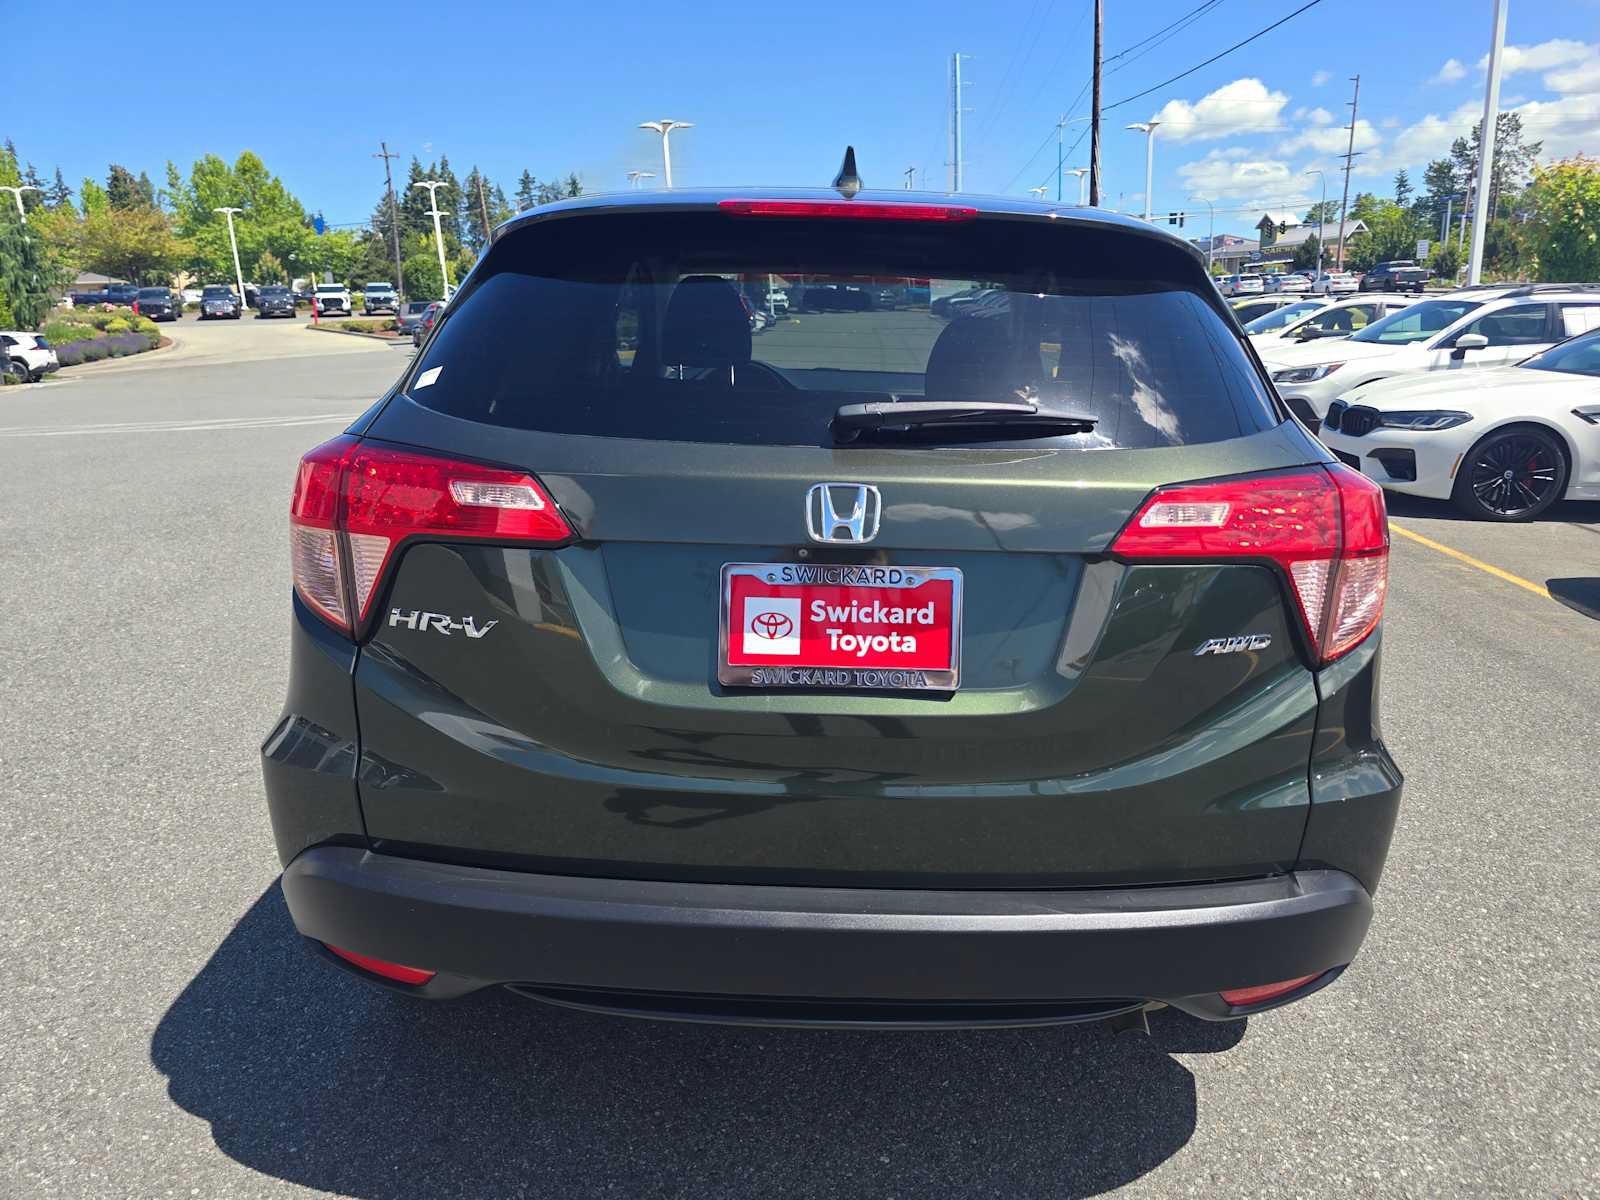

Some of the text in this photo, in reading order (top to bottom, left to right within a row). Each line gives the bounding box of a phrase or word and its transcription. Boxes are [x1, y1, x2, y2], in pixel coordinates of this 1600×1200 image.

[781, 566, 903, 585] SWICKARD
[388, 607, 499, 638] HR-V
[809, 599, 935, 625] Swickard
[825, 628, 917, 657] Toyota
[1193, 633, 1272, 656] AWD
[751, 668, 929, 688] SWICKARD TOYOTA
